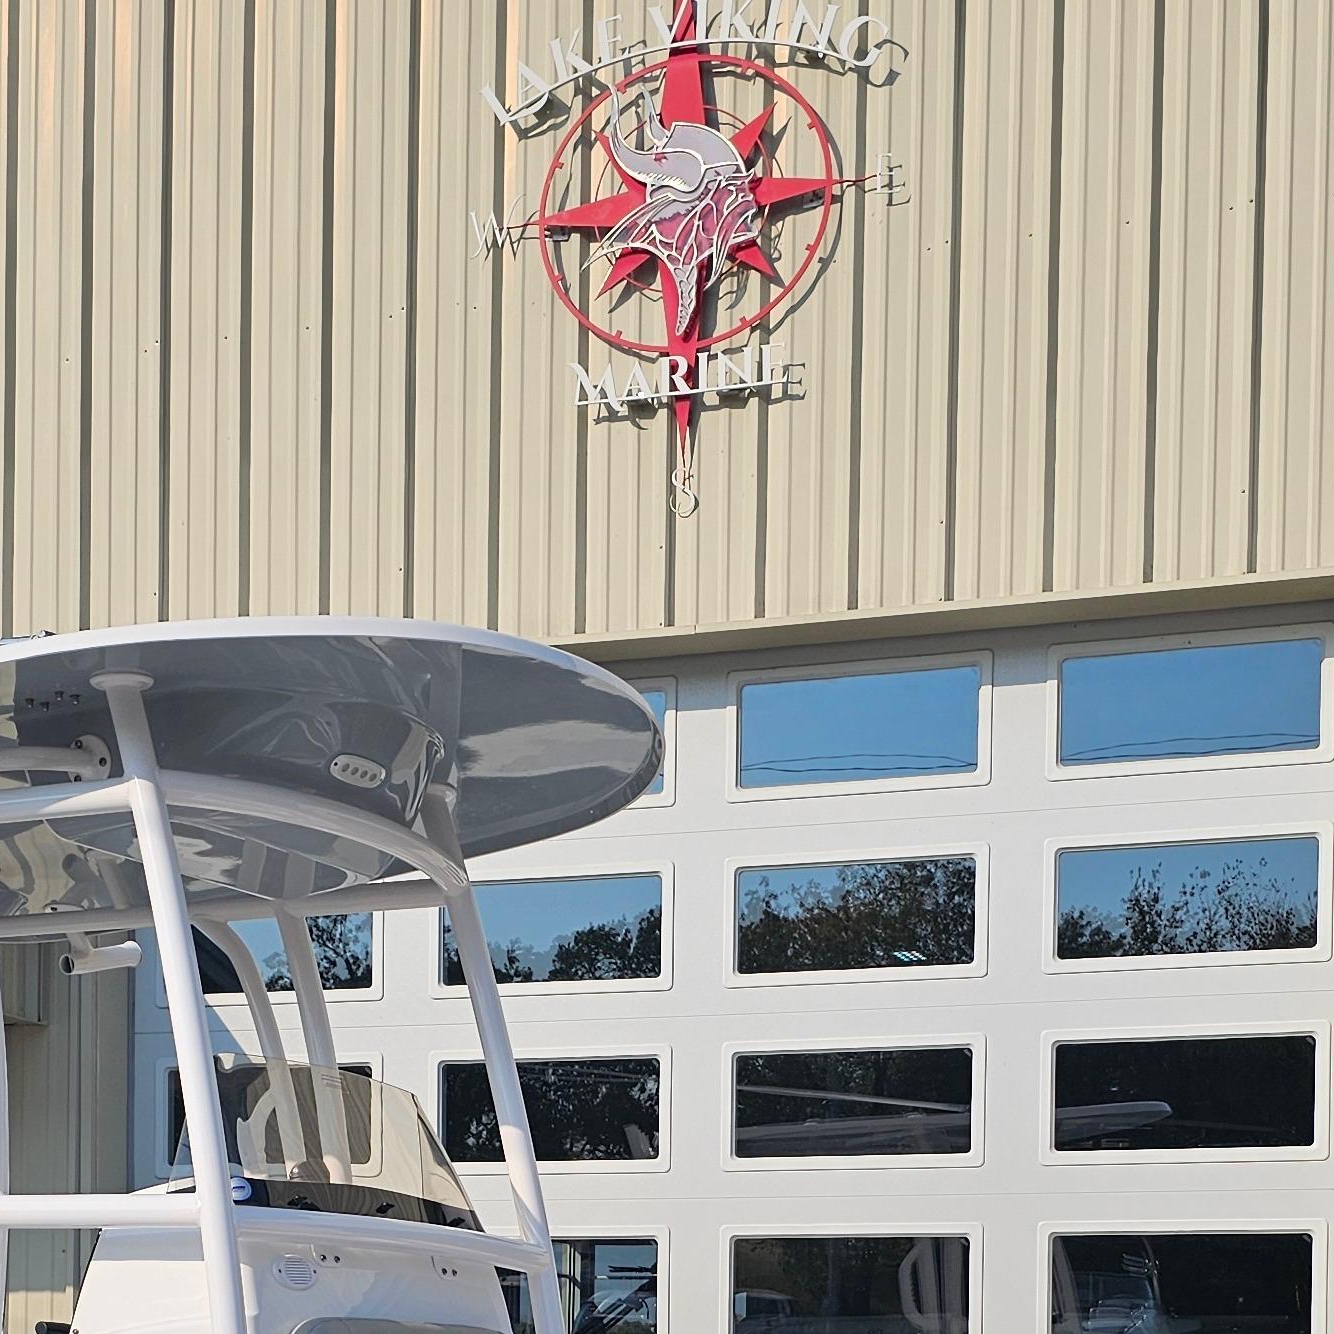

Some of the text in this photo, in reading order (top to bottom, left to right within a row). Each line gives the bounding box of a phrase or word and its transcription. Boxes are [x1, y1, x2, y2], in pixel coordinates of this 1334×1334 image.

[480, 0, 889, 127] LAKE VIKING
[569, 342, 789, 413] MARINE
